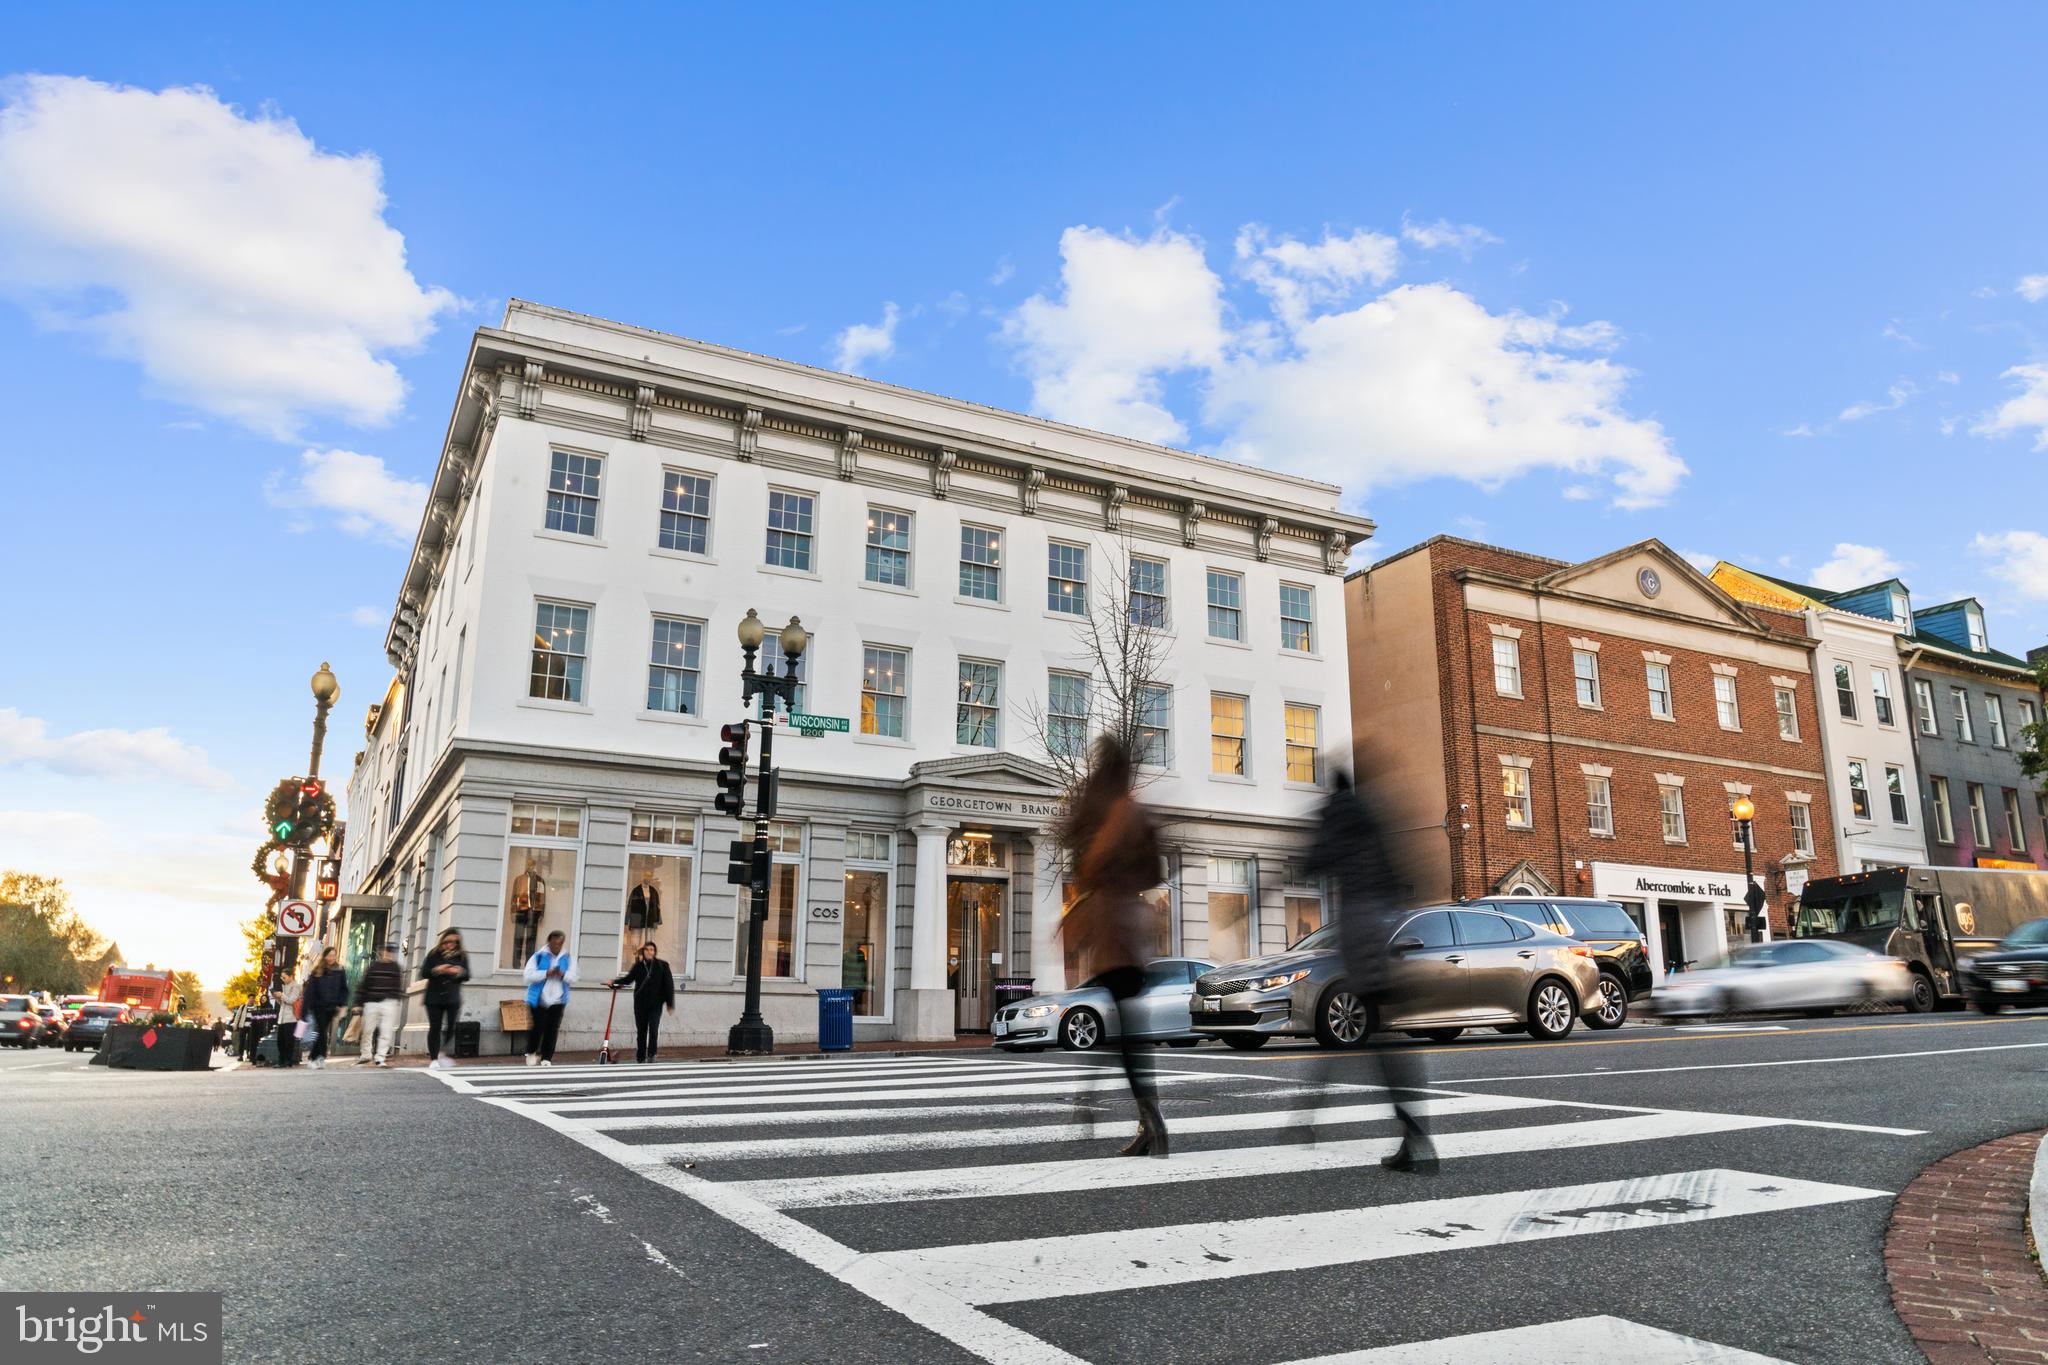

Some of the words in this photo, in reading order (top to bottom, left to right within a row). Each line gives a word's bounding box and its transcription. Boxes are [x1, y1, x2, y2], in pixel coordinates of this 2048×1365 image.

[791, 714, 840, 730] WISCONSIN
[802, 728, 824, 737] 1200
[930, 795, 1012, 812] GEORGETOWN
[1021, 804, 1067, 816] BRANCH
[317, 882, 336, 897] 40
[1635, 877, 1695, 894] Abercrombie
[1698, 885, 1706, 895] &
[1707, 883, 1731, 897] Fitch
[812, 907, 839, 919] COS
